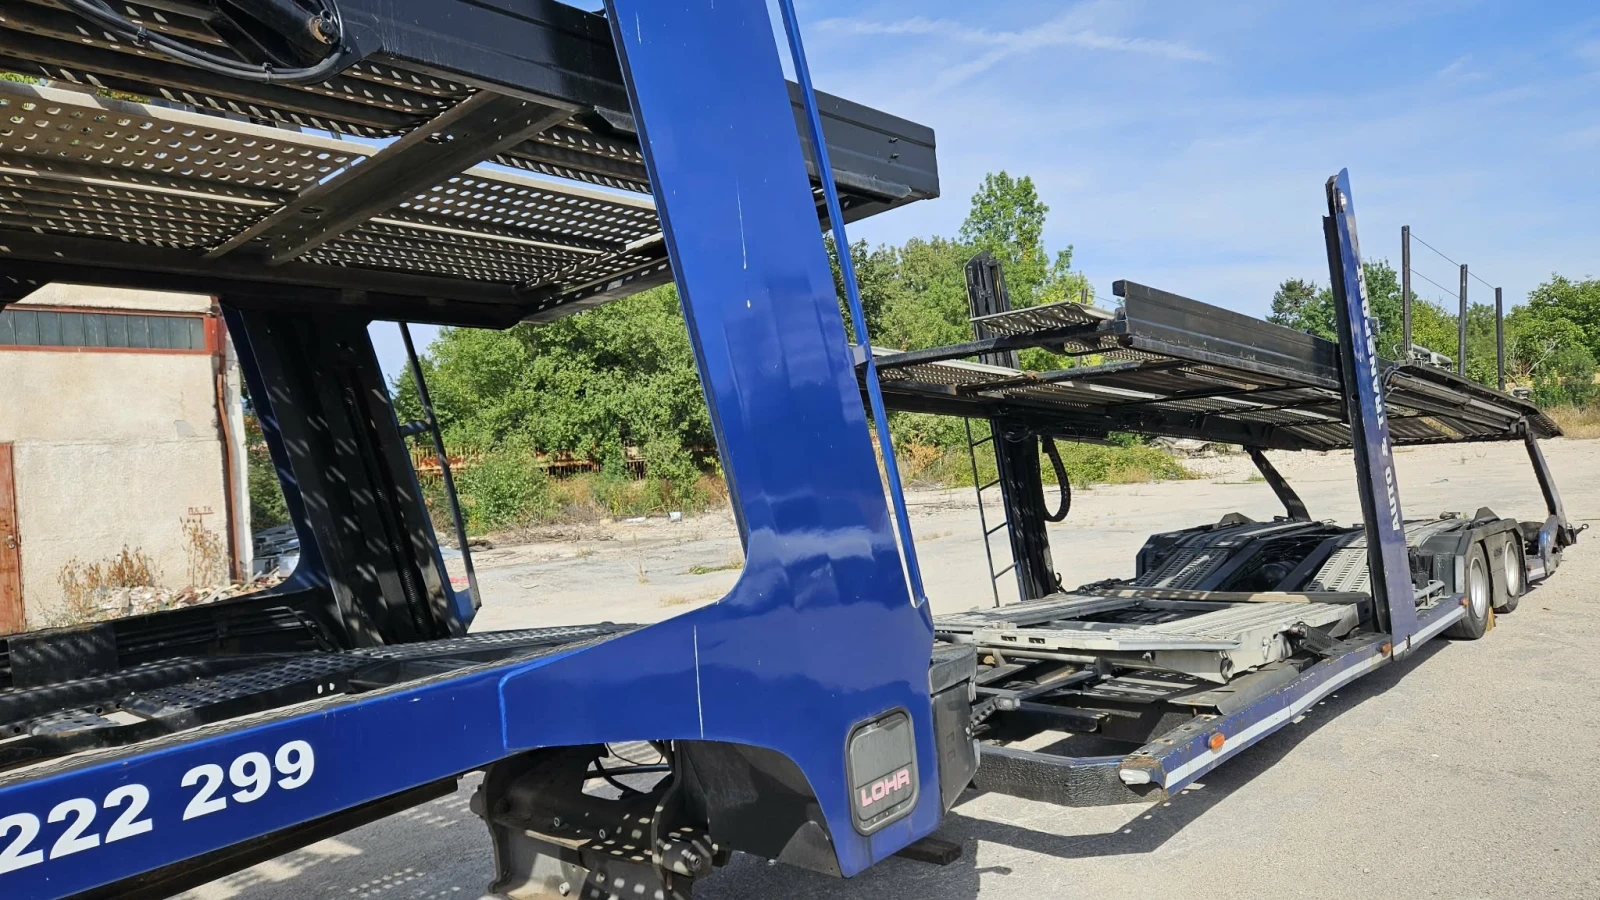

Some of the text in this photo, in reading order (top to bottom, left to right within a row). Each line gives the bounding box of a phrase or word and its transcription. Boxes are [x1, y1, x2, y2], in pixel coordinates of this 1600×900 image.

[1357, 265, 1400, 531] AUTO & TRANSPORT
[0, 740, 315, 875] 222 299
[861, 769, 910, 808] LOHR
